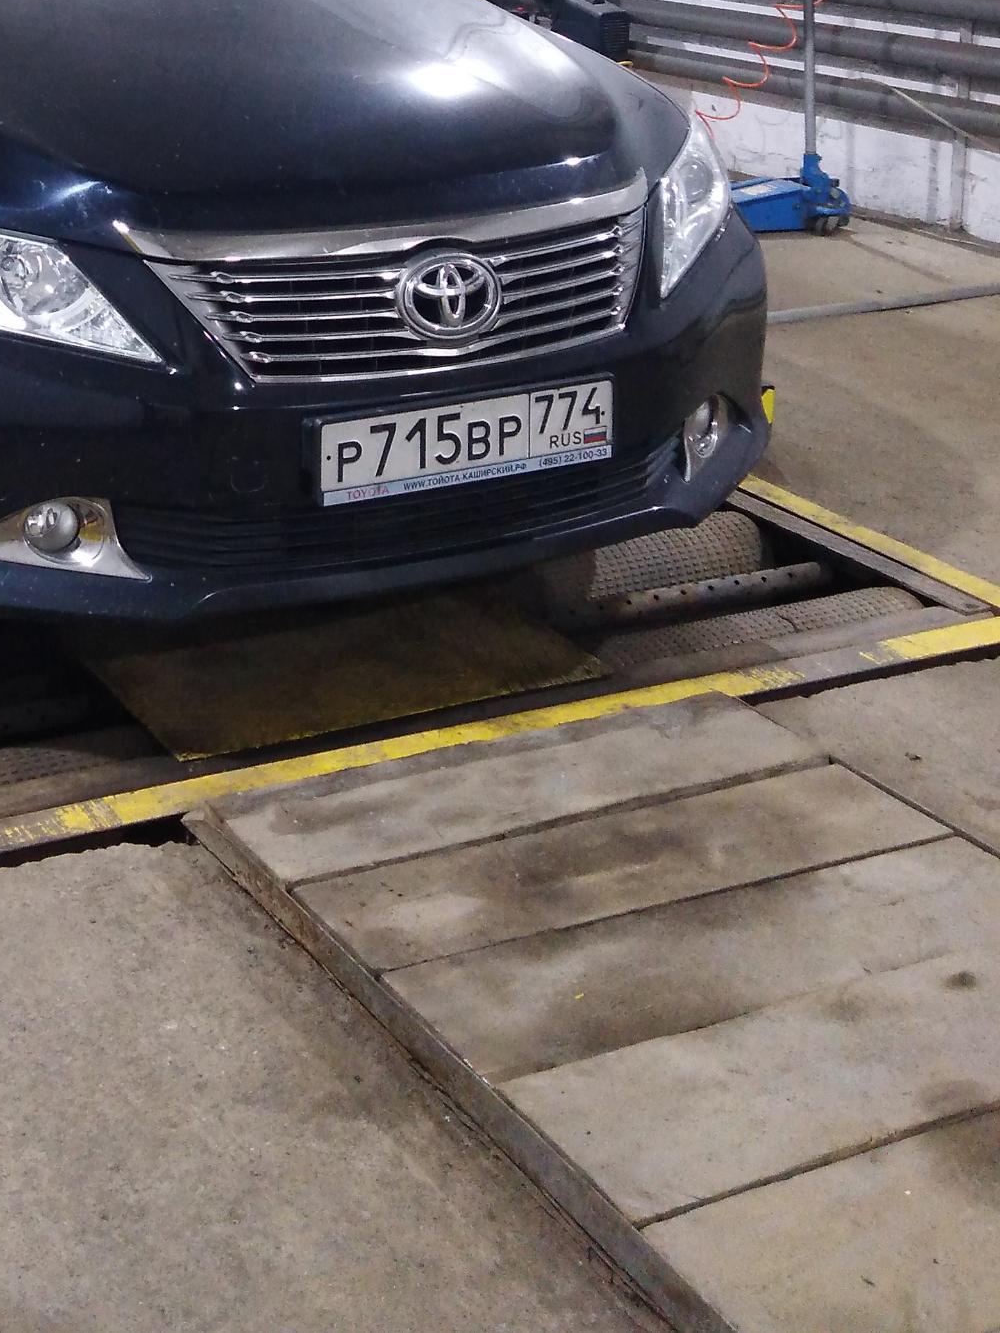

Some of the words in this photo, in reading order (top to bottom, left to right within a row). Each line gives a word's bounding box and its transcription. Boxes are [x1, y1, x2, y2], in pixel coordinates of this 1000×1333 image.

[534, 387, 601, 435] 774
[550, 431, 582, 449] RUS
[347, 485, 390, 500] TOYOTA
